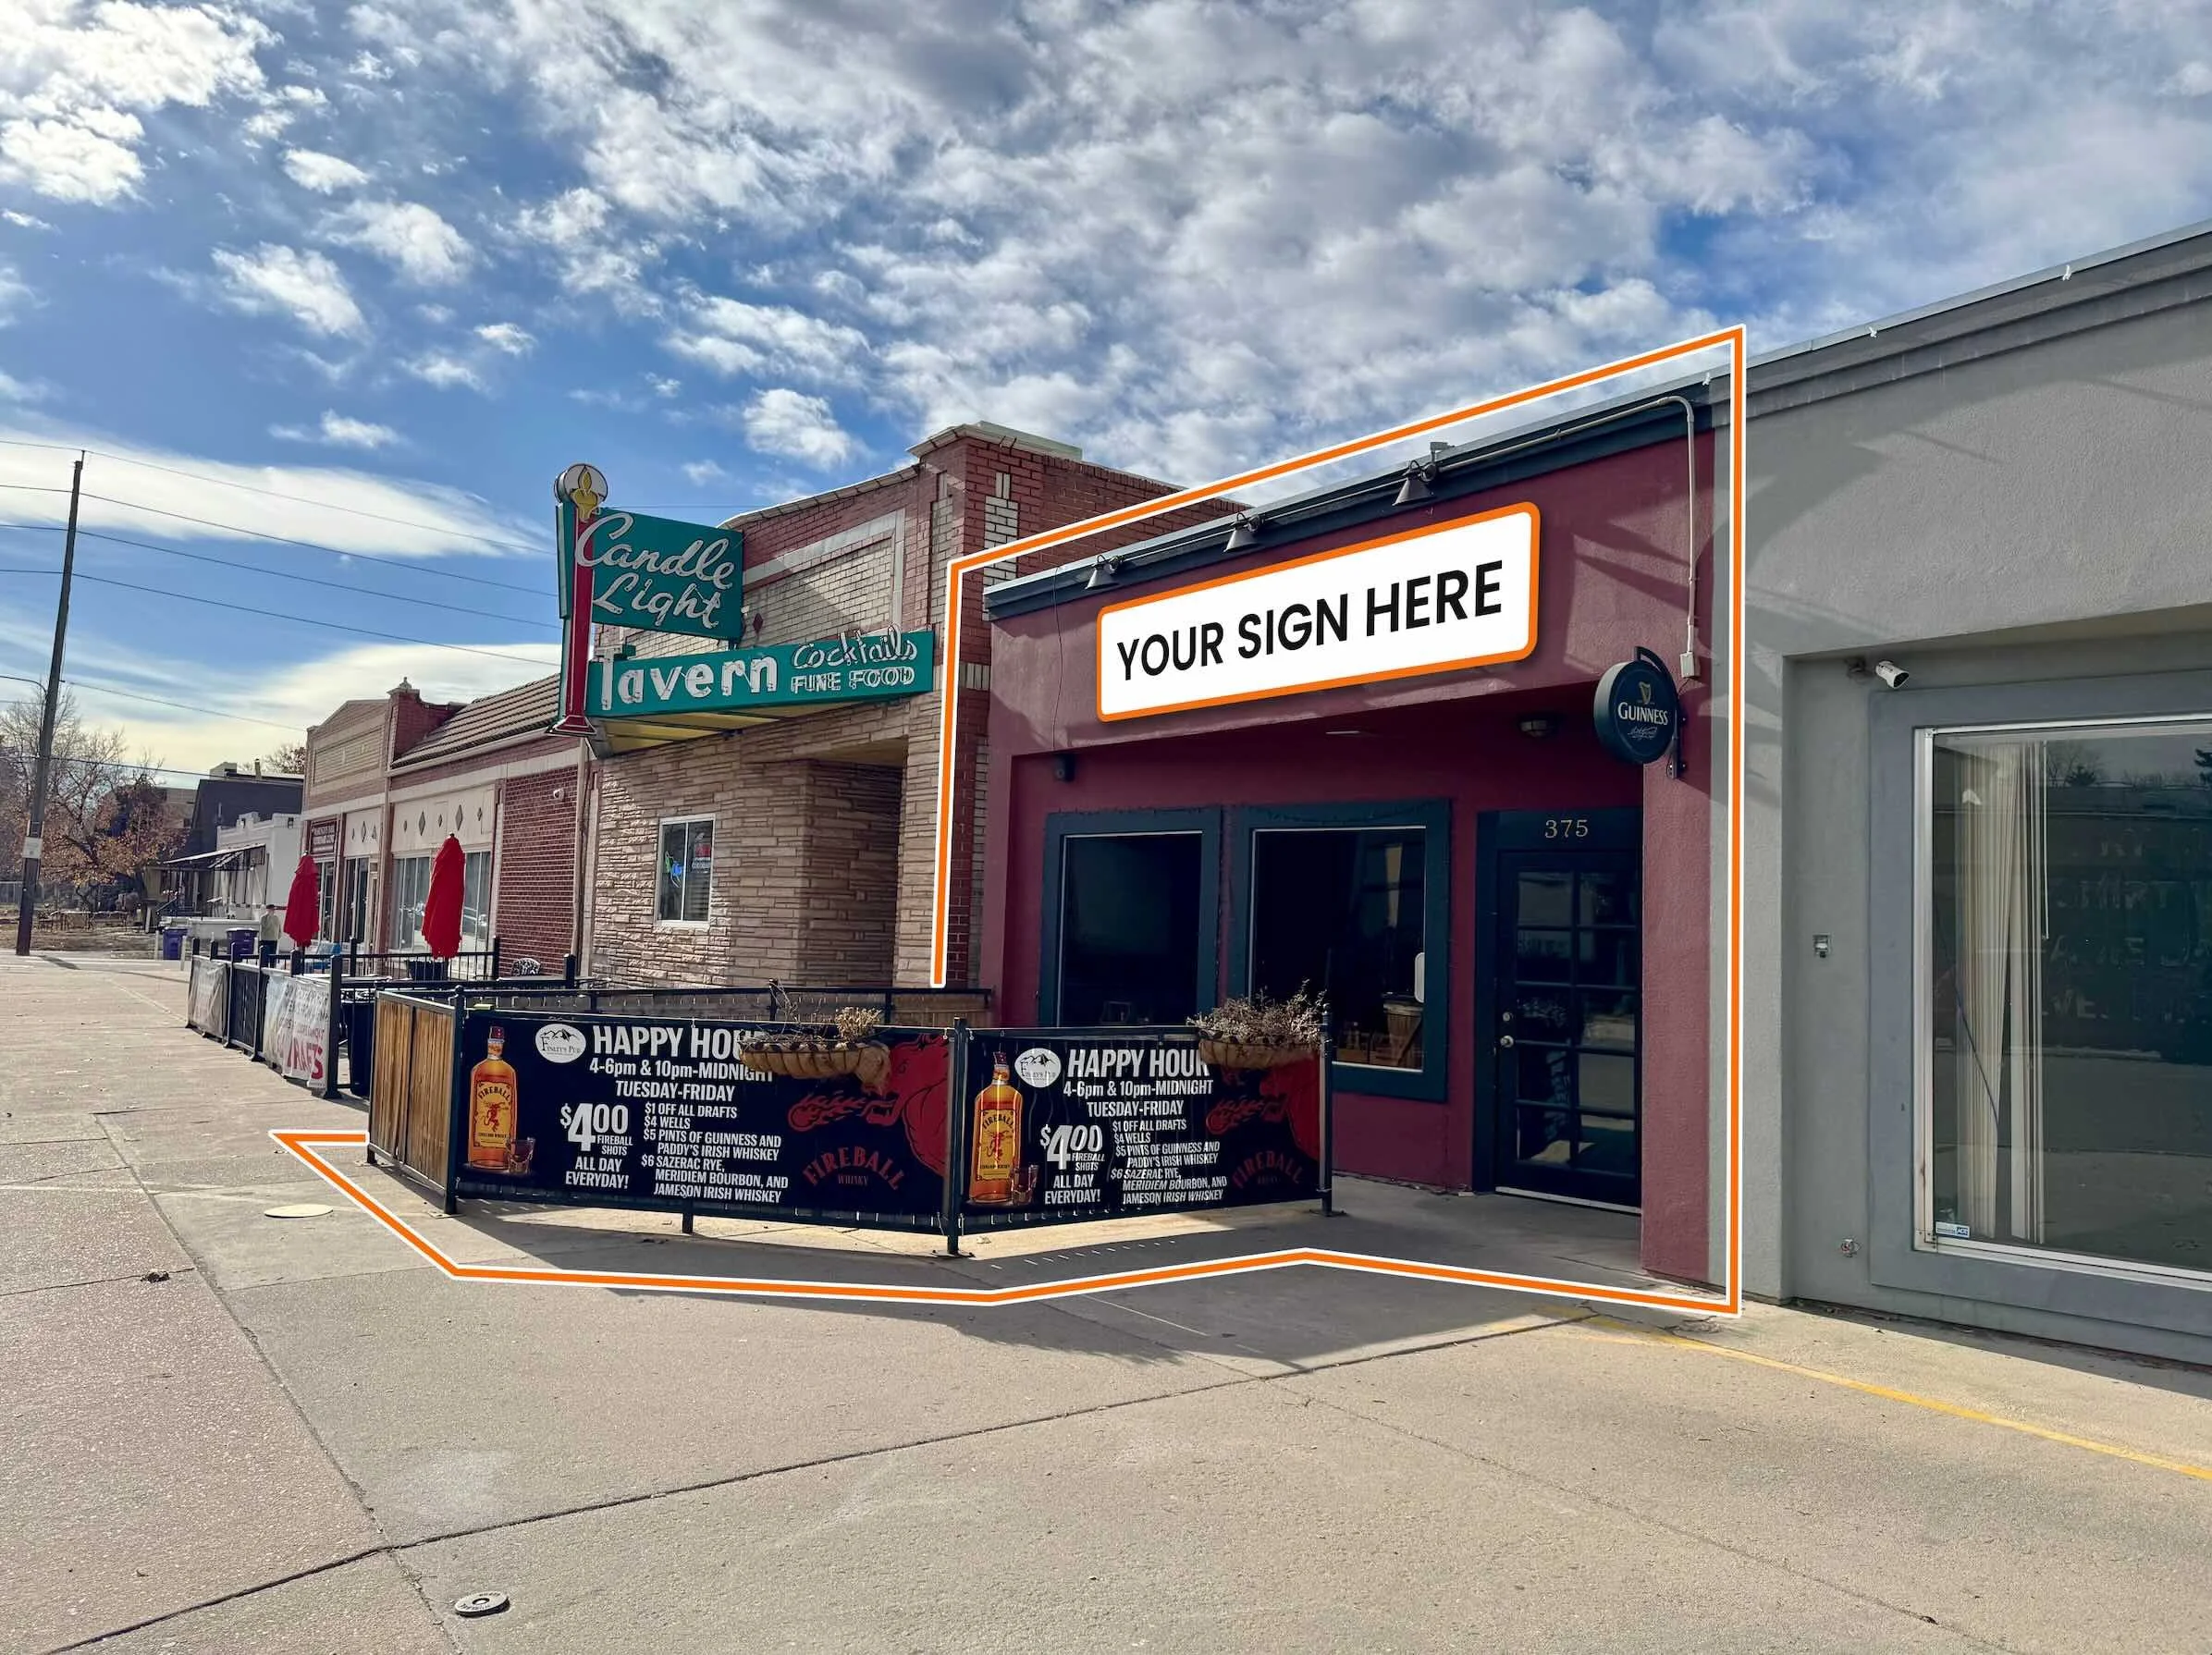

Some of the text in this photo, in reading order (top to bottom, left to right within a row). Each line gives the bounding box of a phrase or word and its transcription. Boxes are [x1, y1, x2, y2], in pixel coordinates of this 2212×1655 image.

[575, 512, 736, 591] Candle
[593, 573, 720, 630] Light
[793, 623, 917, 668] Cocktails
[595, 648, 778, 711] Tavern
[791, 666, 916, 693] FINE FOOD
[1617, 702, 1668, 726] GUINNESS
[1544, 819, 1589, 839] 375
[593, 1025, 683, 1058] HAPPY
[590, 1058, 635, 1078] 4-6pm
[640, 1060, 651, 1076] &
[1067, 1049, 1145, 1077] HAPPY
[616, 1081, 735, 1102] TUESDAY-FRIDAY
[1063, 1080, 1213, 1099] 4-6pm & 10pm-MIDNIGHT
[645, 1102, 737, 1119] $1 OFF ALL DRAFTS
[1087, 1100, 1184, 1117] TUESDAY-FRIDAY
[645, 1115, 690, 1129] $4 WELLS
[1112, 1119, 1186, 1133] $1 OFF ALL DRAFTS
[596, 1134, 633, 1146] FIREBALL
[644, 1128, 781, 1147] $5 PINTS OF GUINNESS AND
[1114, 1132, 1150, 1145] $4 WELLS
[601, 1145, 628, 1156] SHOTS
[657, 1143, 779, 1160] PADDY'S IRISH WHISKEY
[1072, 1152, 1105, 1161] FIREBALL
[1116, 1141, 1220, 1157] $5 PINTS OF GUINNESS AND
[575, 1157, 622, 1172] ALL DAY
[642, 1154, 725, 1172] $6 SAZERAC RYE,
[803, 1146, 904, 1190] FIREBALL
[1075, 1162, 1099, 1171] SHOTS
[1127, 1153, 1218, 1168] PADDY'S IRISH WHISKEY
[565, 1171, 629, 1189] EVERYDAY!
[656, 1169, 788, 1188] MERIDIEM BOURBON, AND
[1053, 1174, 1094, 1188] ALL DAY
[1111, 1169, 1123, 1180] $6
[1124, 1169, 1163, 1179] SAZERAC
[1123, 1180, 1167, 1191] MERIDIEM
[1211, 1176, 1227, 1187] AND
[654, 1183, 781, 1203] JAMESON IRISH WHISKEY
[1045, 1189, 1100, 1205] EVERYDAY!
[1123, 1190, 1223, 1205] JAMESON IRISH WHISKEY
